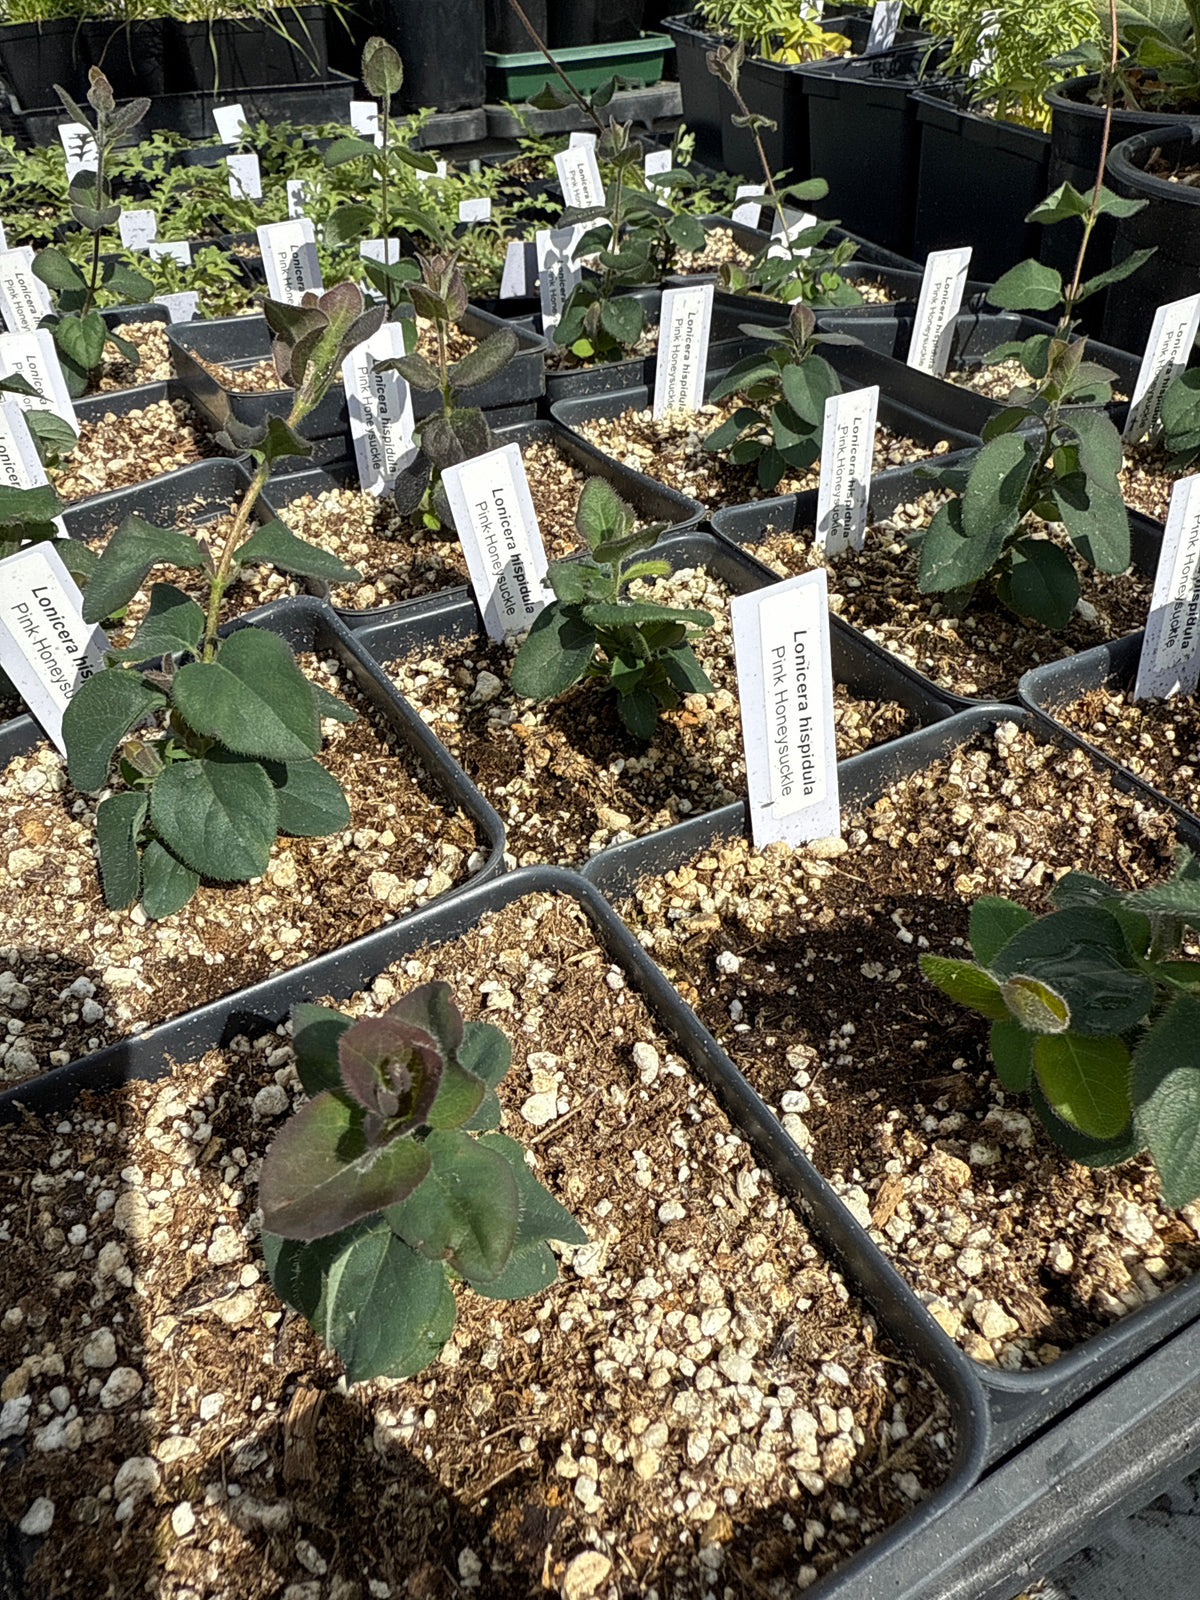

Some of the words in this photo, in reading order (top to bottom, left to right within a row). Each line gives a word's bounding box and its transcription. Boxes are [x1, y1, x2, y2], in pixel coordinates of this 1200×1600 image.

[577, 163, 590, 200] Lonicera
[278, 251, 289, 275] Pink
[290, 244, 305, 292] Lonicera
[4, 279, 19, 300] Pink
[15, 272, 38, 320] Lonicera
[931, 282, 942, 305] Pink
[938, 276, 953, 321] Lonicera
[673, 318, 683, 342] Pink
[683, 312, 696, 361] Lonicera
[928, 323, 943, 370] hispidula
[1160, 331, 1174, 357] Pink
[11, 361, 24, 374] Pi
[26, 355, 48, 405] Lonicea
[666, 344, 680, 410] Honeysuckle
[678, 364, 690, 413] hispidula
[357, 366, 369, 394] Pink
[363, 396, 382, 471] Honeysuckle
[372, 359, 388, 414] Lnicera
[381, 417, 399, 474] hispidula
[1151, 376, 1171, 430] hispidul
[0, 436, 21, 487] onicer
[837, 425, 849, 456] Pink
[849, 417, 862, 476] Lonicera
[830, 457, 846, 537] Honeysuckle
[842, 478, 856, 538] hispidula
[475, 500, 492, 534] Pink
[485, 534, 516, 616] Honeysuckle
[492, 488, 517, 551] Lonicera
[510, 553, 535, 615] hispidula
[31, 586, 79, 654] Lonicera
[1165, 552, 1199, 649] Honeysuckle
[11, 602, 40, 638] Pink
[32, 637, 74, 700] Honeysu
[770, 645, 787, 687] Pink
[793, 630, 809, 712] Lonicera
[774, 688, 796, 798] Honeysuckle
[796, 716, 817, 796] hispidula
